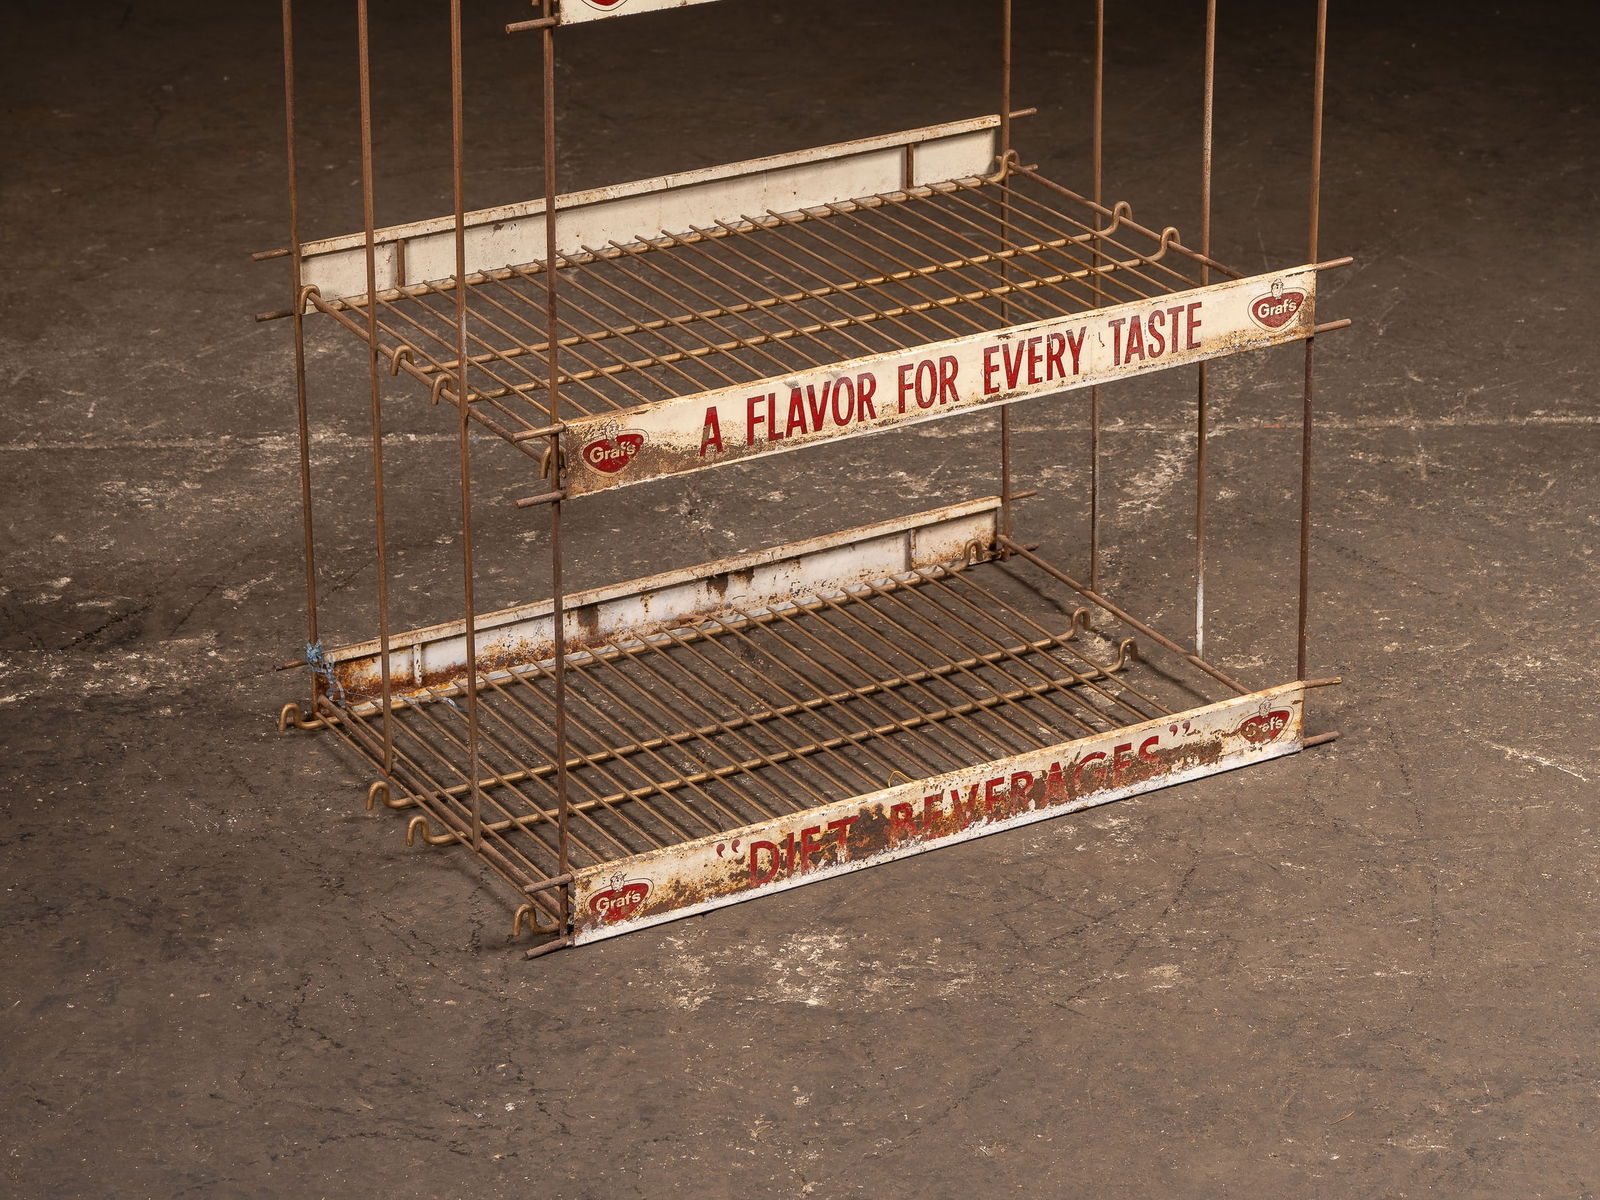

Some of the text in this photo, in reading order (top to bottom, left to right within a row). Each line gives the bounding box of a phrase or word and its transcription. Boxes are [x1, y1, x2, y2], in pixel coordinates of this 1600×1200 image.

[1256, 298, 1297, 319] Graf's
[700, 302, 1203, 457] A FLAVOR FOR EVERY TASTE
[589, 441, 636, 463] Graf's
[596, 889, 642, 908] Graf's
